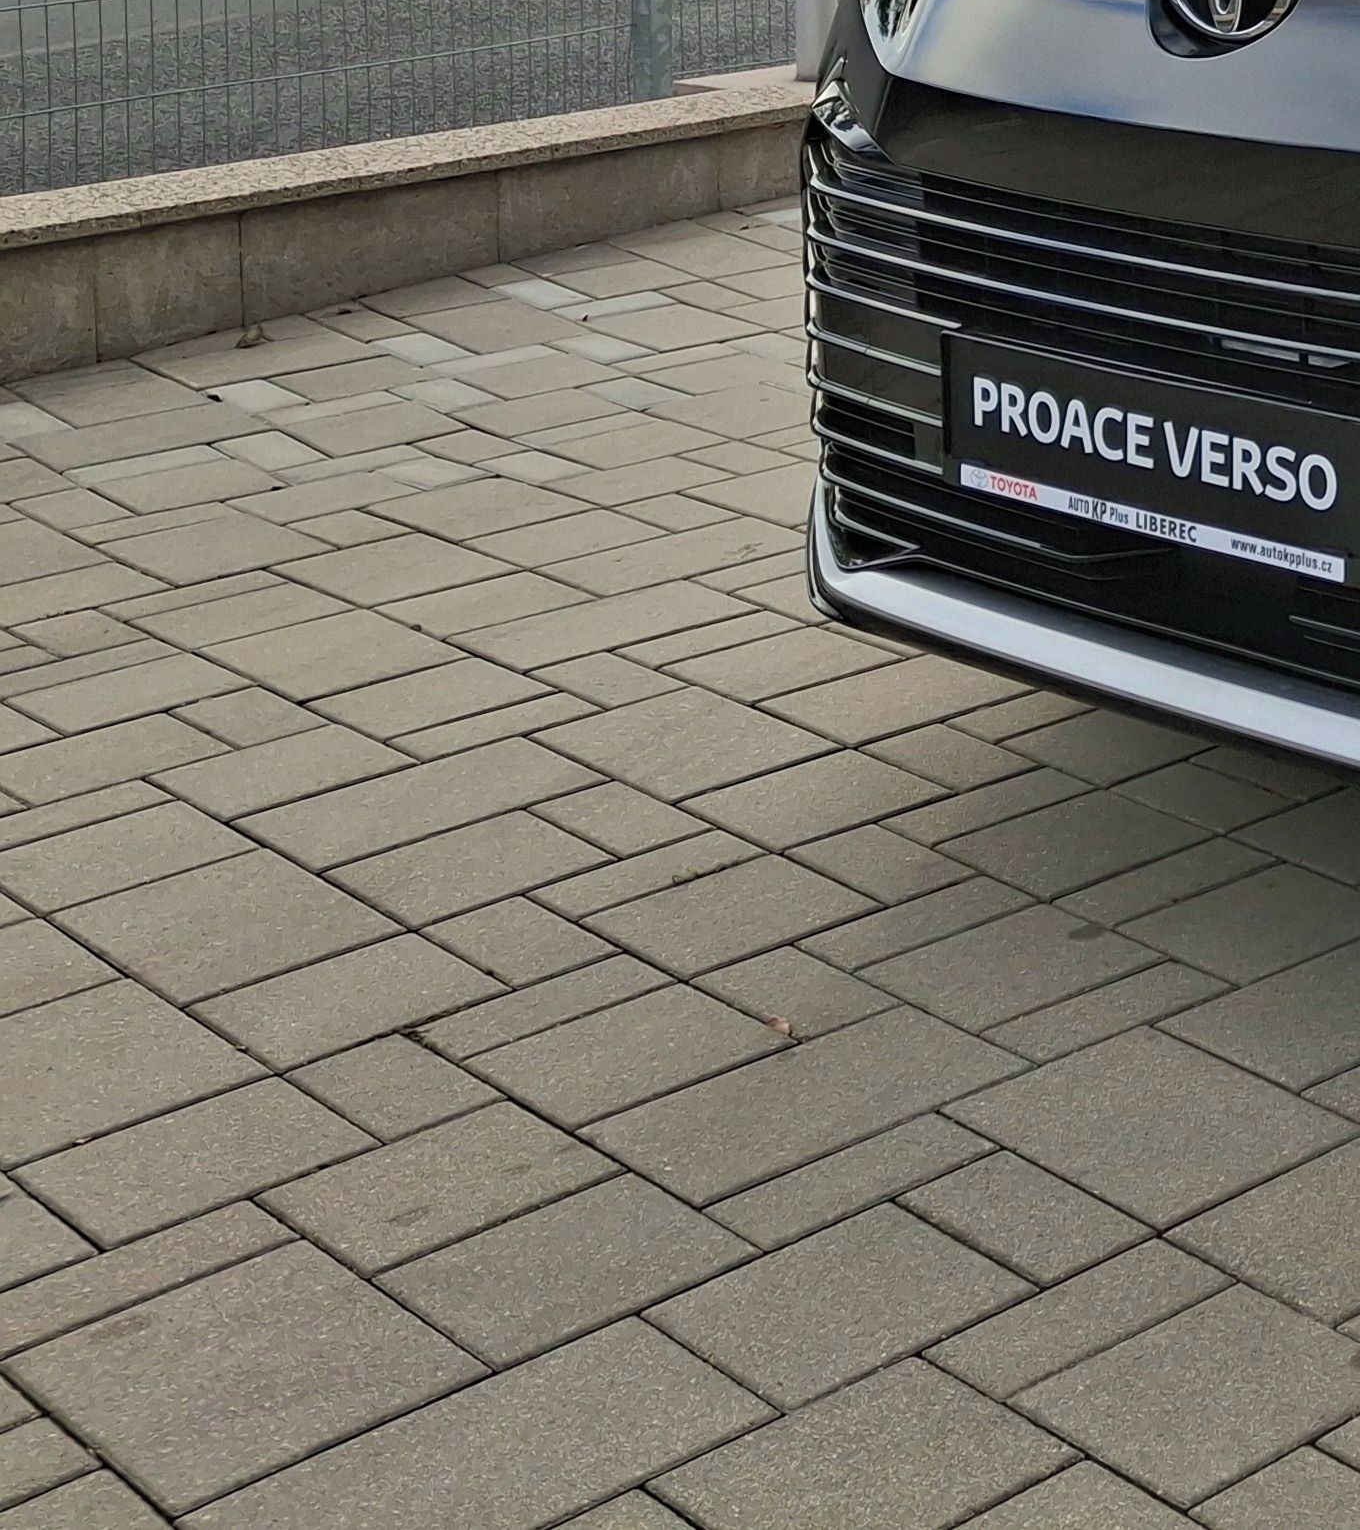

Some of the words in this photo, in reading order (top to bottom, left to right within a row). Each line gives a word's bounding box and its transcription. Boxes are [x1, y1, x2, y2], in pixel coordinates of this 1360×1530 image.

[972, 375, 1155, 470] PROACE
[1163, 420, 1338, 512] VERSO
[990, 475, 1038, 501] TOYOTA
[1067, 496, 1089, 515] AUTO
[1091, 499, 1107, 521] KP
[1109, 506, 1129, 525] Plus
[1135, 511, 1198, 544] LIBEREC
[1230, 537, 1333, 574] www.autokpplus.cz
